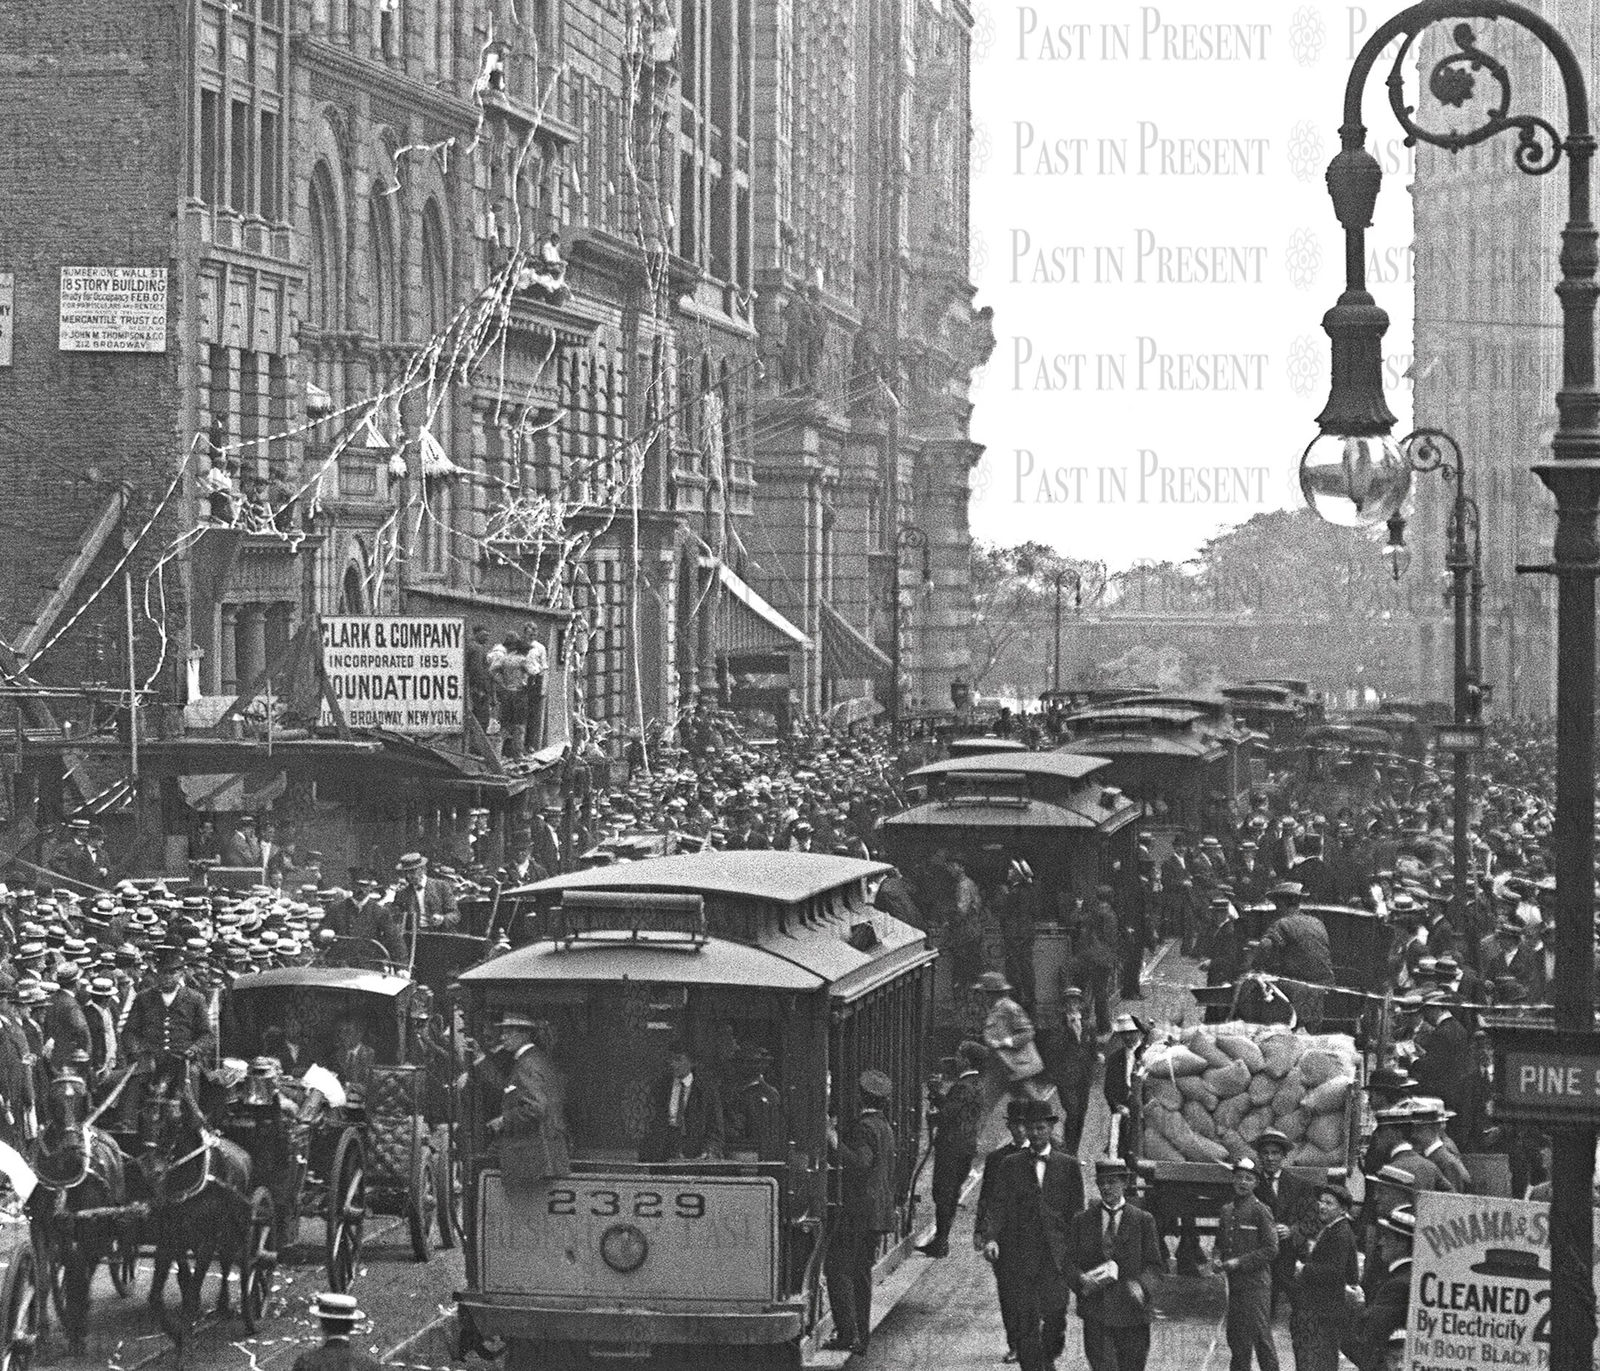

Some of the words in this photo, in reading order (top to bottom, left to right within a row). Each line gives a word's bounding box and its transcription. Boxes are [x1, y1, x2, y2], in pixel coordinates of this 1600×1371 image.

[62, 268, 99, 277] NUMBER
[101, 268, 119, 277] ONE
[121, 269, 148, 278] WALL
[62, 279, 73, 290] 18
[74, 278, 110, 291] STORY
[112, 279, 166, 292] BUILDING
[61, 315, 117, 324] MERCANTILE
[120, 316, 150, 325] TRUST
[75, 340, 91, 349] 212
[375, 622, 387, 648] &
[390, 622, 462, 649] COMPANY
[329, 655, 414, 669] INCORPORATED
[328, 674, 462, 701] OUNDATIONS.
[407, 710, 431, 726] NEW
[1520, 1065, 1582, 1095] PINE
[548, 1188, 706, 1219] 2329
[1421, 1210, 1515, 1259] PANAMA
[1419, 1271, 1531, 1316] CLEANED
[1417, 1309, 1438, 1339] By
[1441, 1312, 1528, 1346] Electricity
[1480, 1343, 1531, 1367] BLACK
